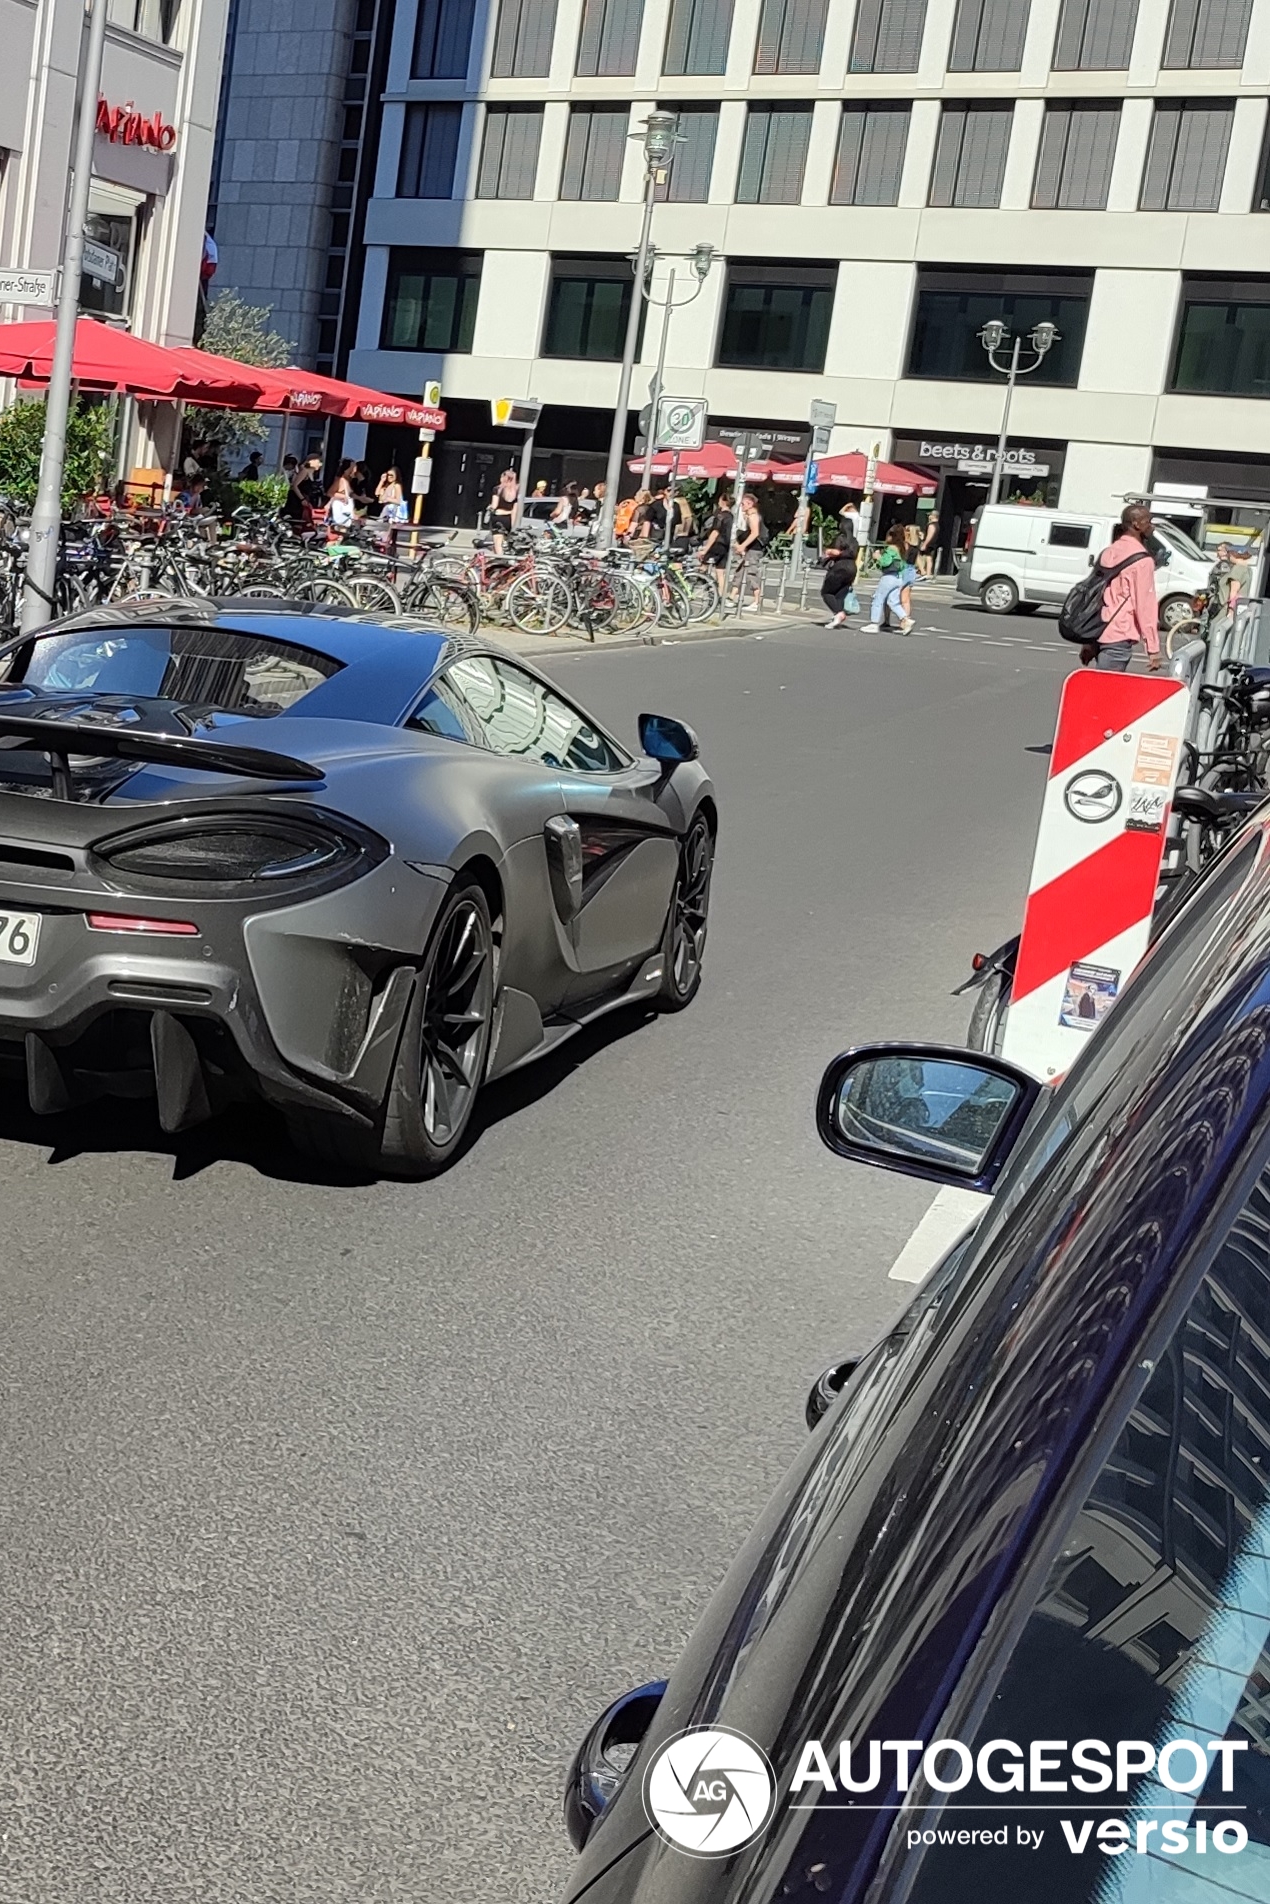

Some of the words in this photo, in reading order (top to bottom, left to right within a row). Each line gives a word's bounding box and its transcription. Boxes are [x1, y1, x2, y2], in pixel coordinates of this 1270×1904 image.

[95, 92, 176, 151] APIANO
[673, 412, 690, 427] 30
[920, 441, 970, 460] beets
[971, 445, 984, 460] &
[986, 448, 1036, 464] roots
